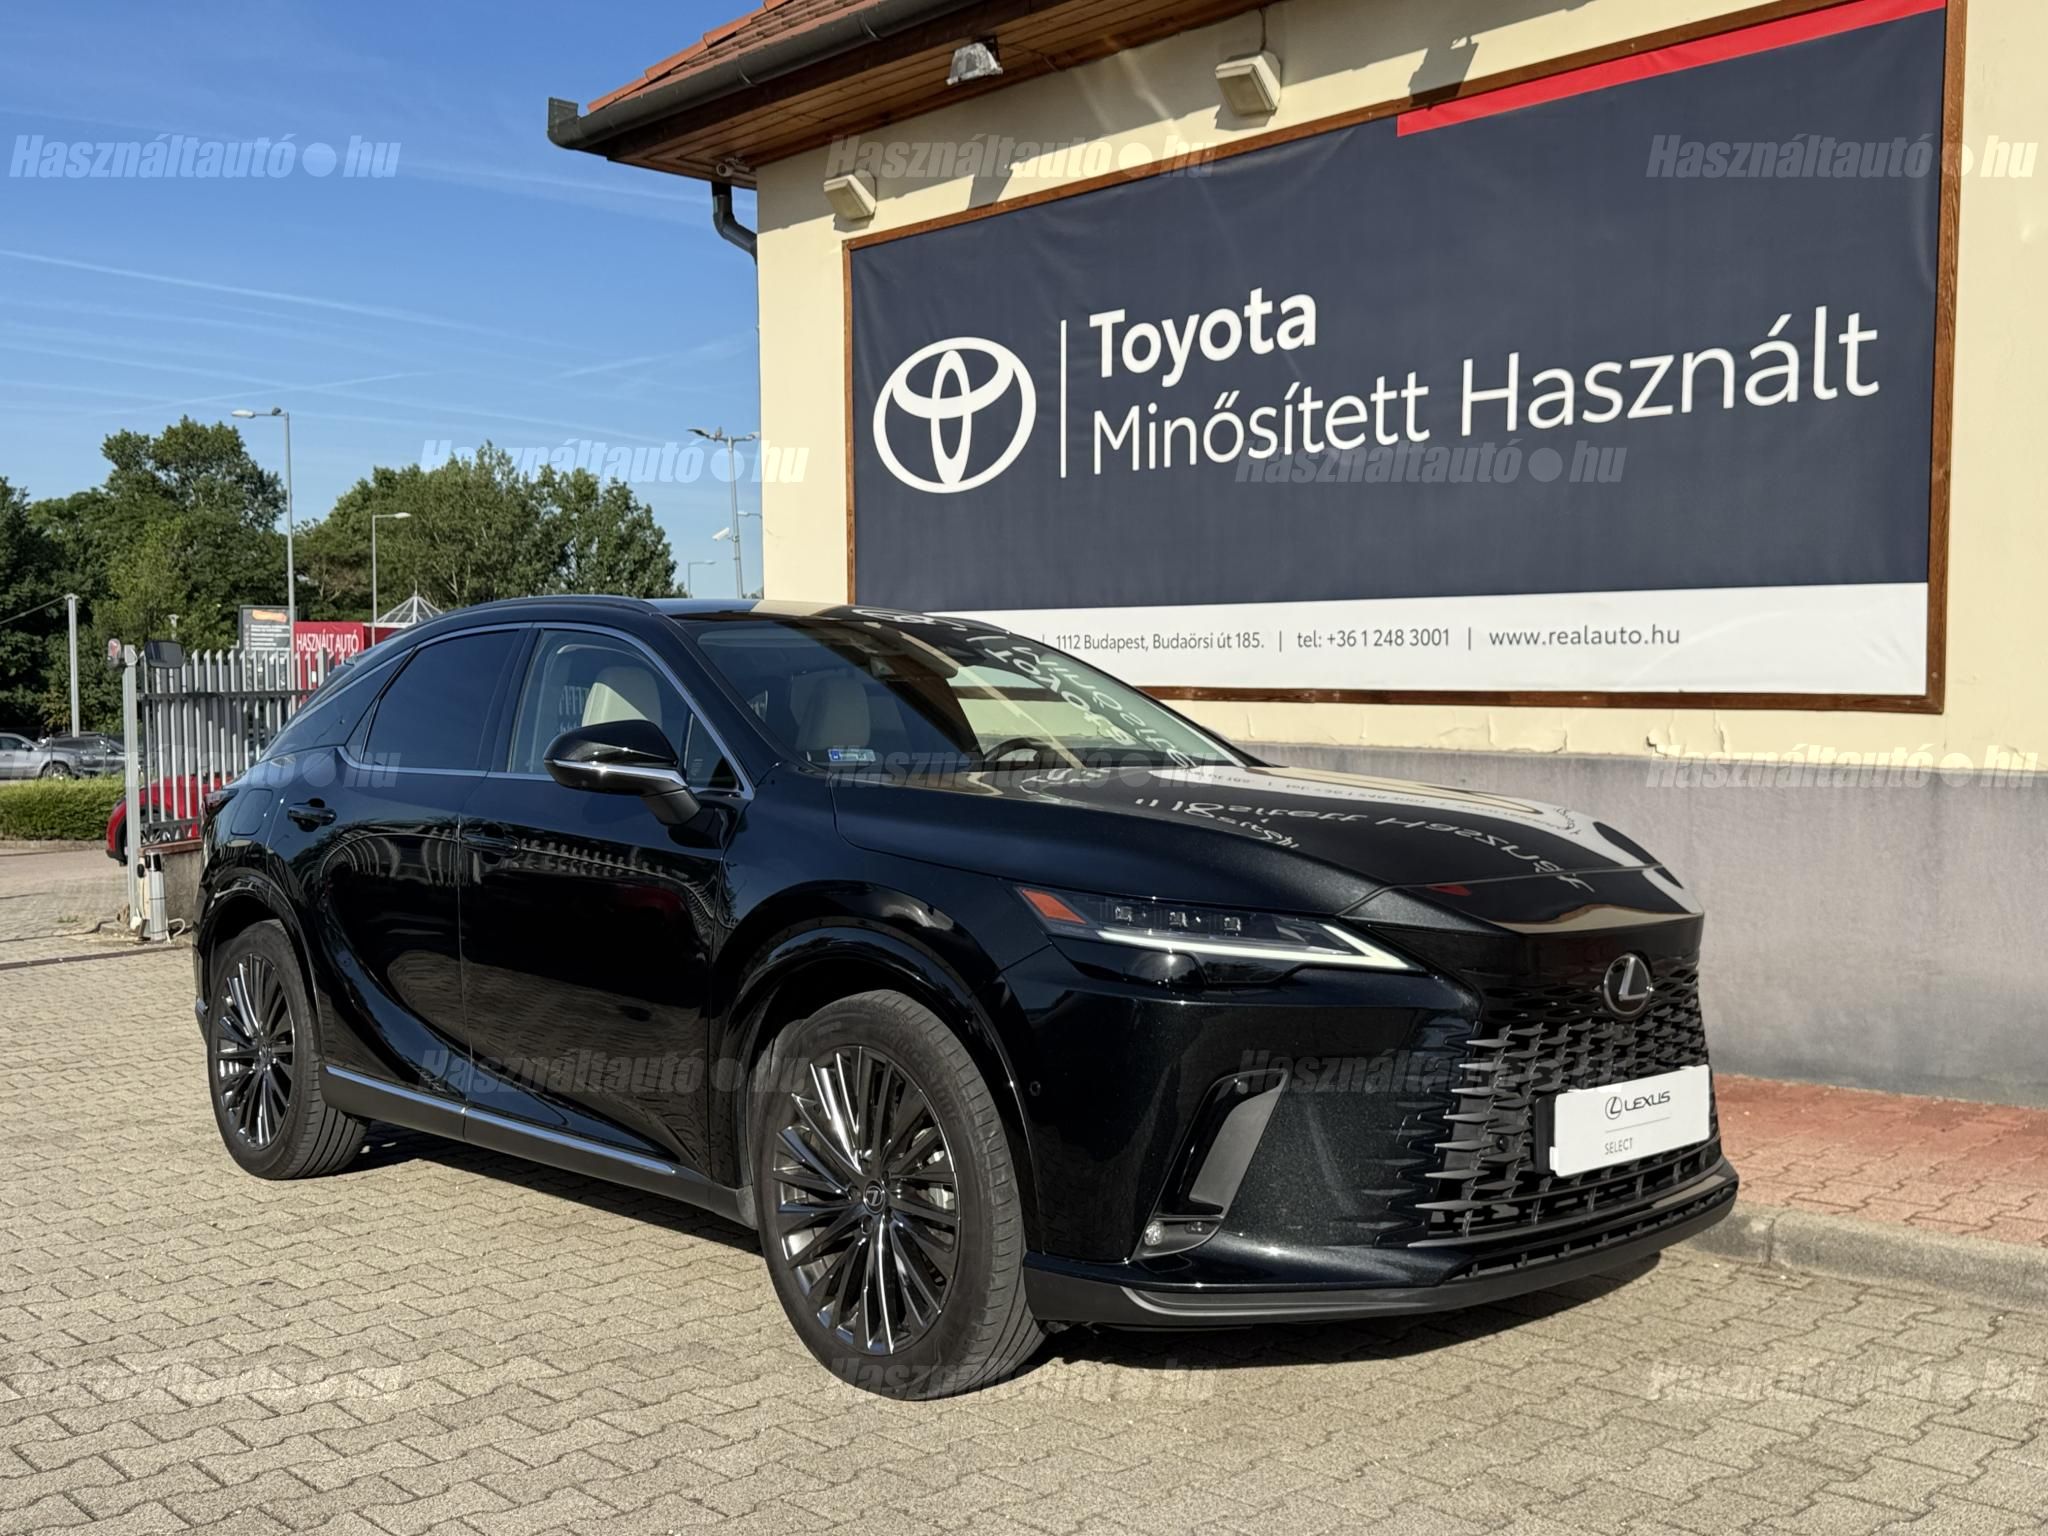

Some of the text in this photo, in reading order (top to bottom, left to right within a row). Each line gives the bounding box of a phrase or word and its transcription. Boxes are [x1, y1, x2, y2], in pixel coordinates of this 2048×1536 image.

[1089, 287, 1316, 387] Toyota
[1093, 305, 1880, 475] Minősített Használt
[296, 630, 334, 653] HASZNÁLT
[335, 629, 359, 653] AUTÓ
[1056, 631, 1265, 653] 1112 Budapest, Budaörsi út 185.
[1297, 630, 1322, 648] tel:
[1326, 630, 1357, 647] +36
[1373, 629, 1404, 647] 248
[1409, 628, 1450, 646] 3001
[1489, 625, 1681, 645] www.realauto.hu
[1624, 1090, 1671, 1111] LEXUS
[1604, 1137, 1633, 1155] SELECT
